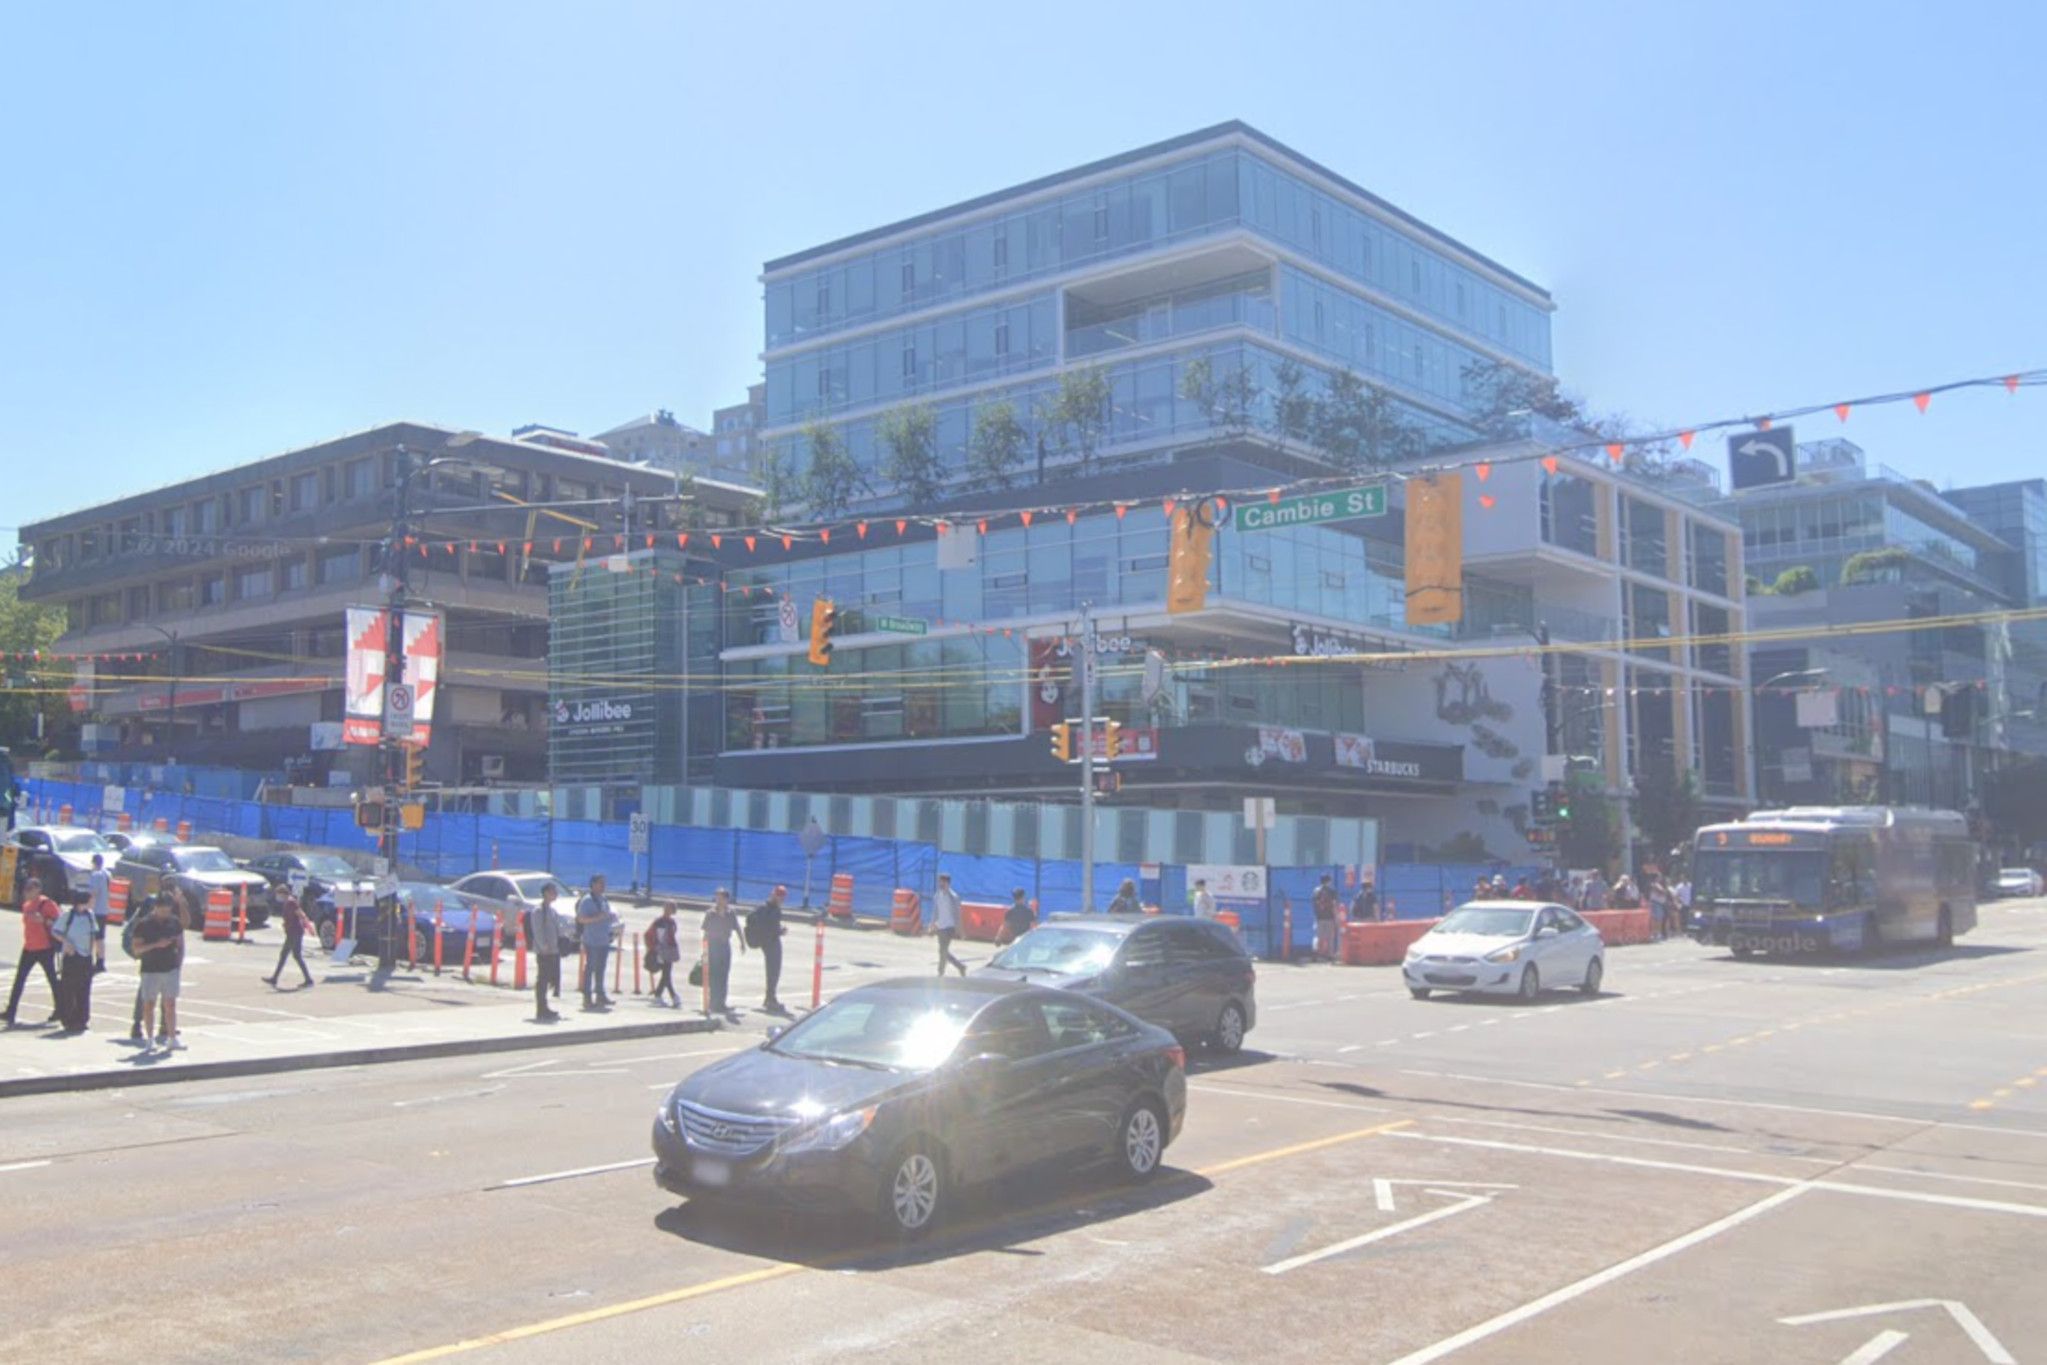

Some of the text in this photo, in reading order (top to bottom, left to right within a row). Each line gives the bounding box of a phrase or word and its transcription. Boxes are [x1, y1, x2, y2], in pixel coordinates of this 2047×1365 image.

[1244, 492, 1375, 527] Cambie St
[573, 700, 632, 722] Jollibee
[1366, 759, 1421, 776] STARBUCKS
[631, 820, 647, 835] 30
